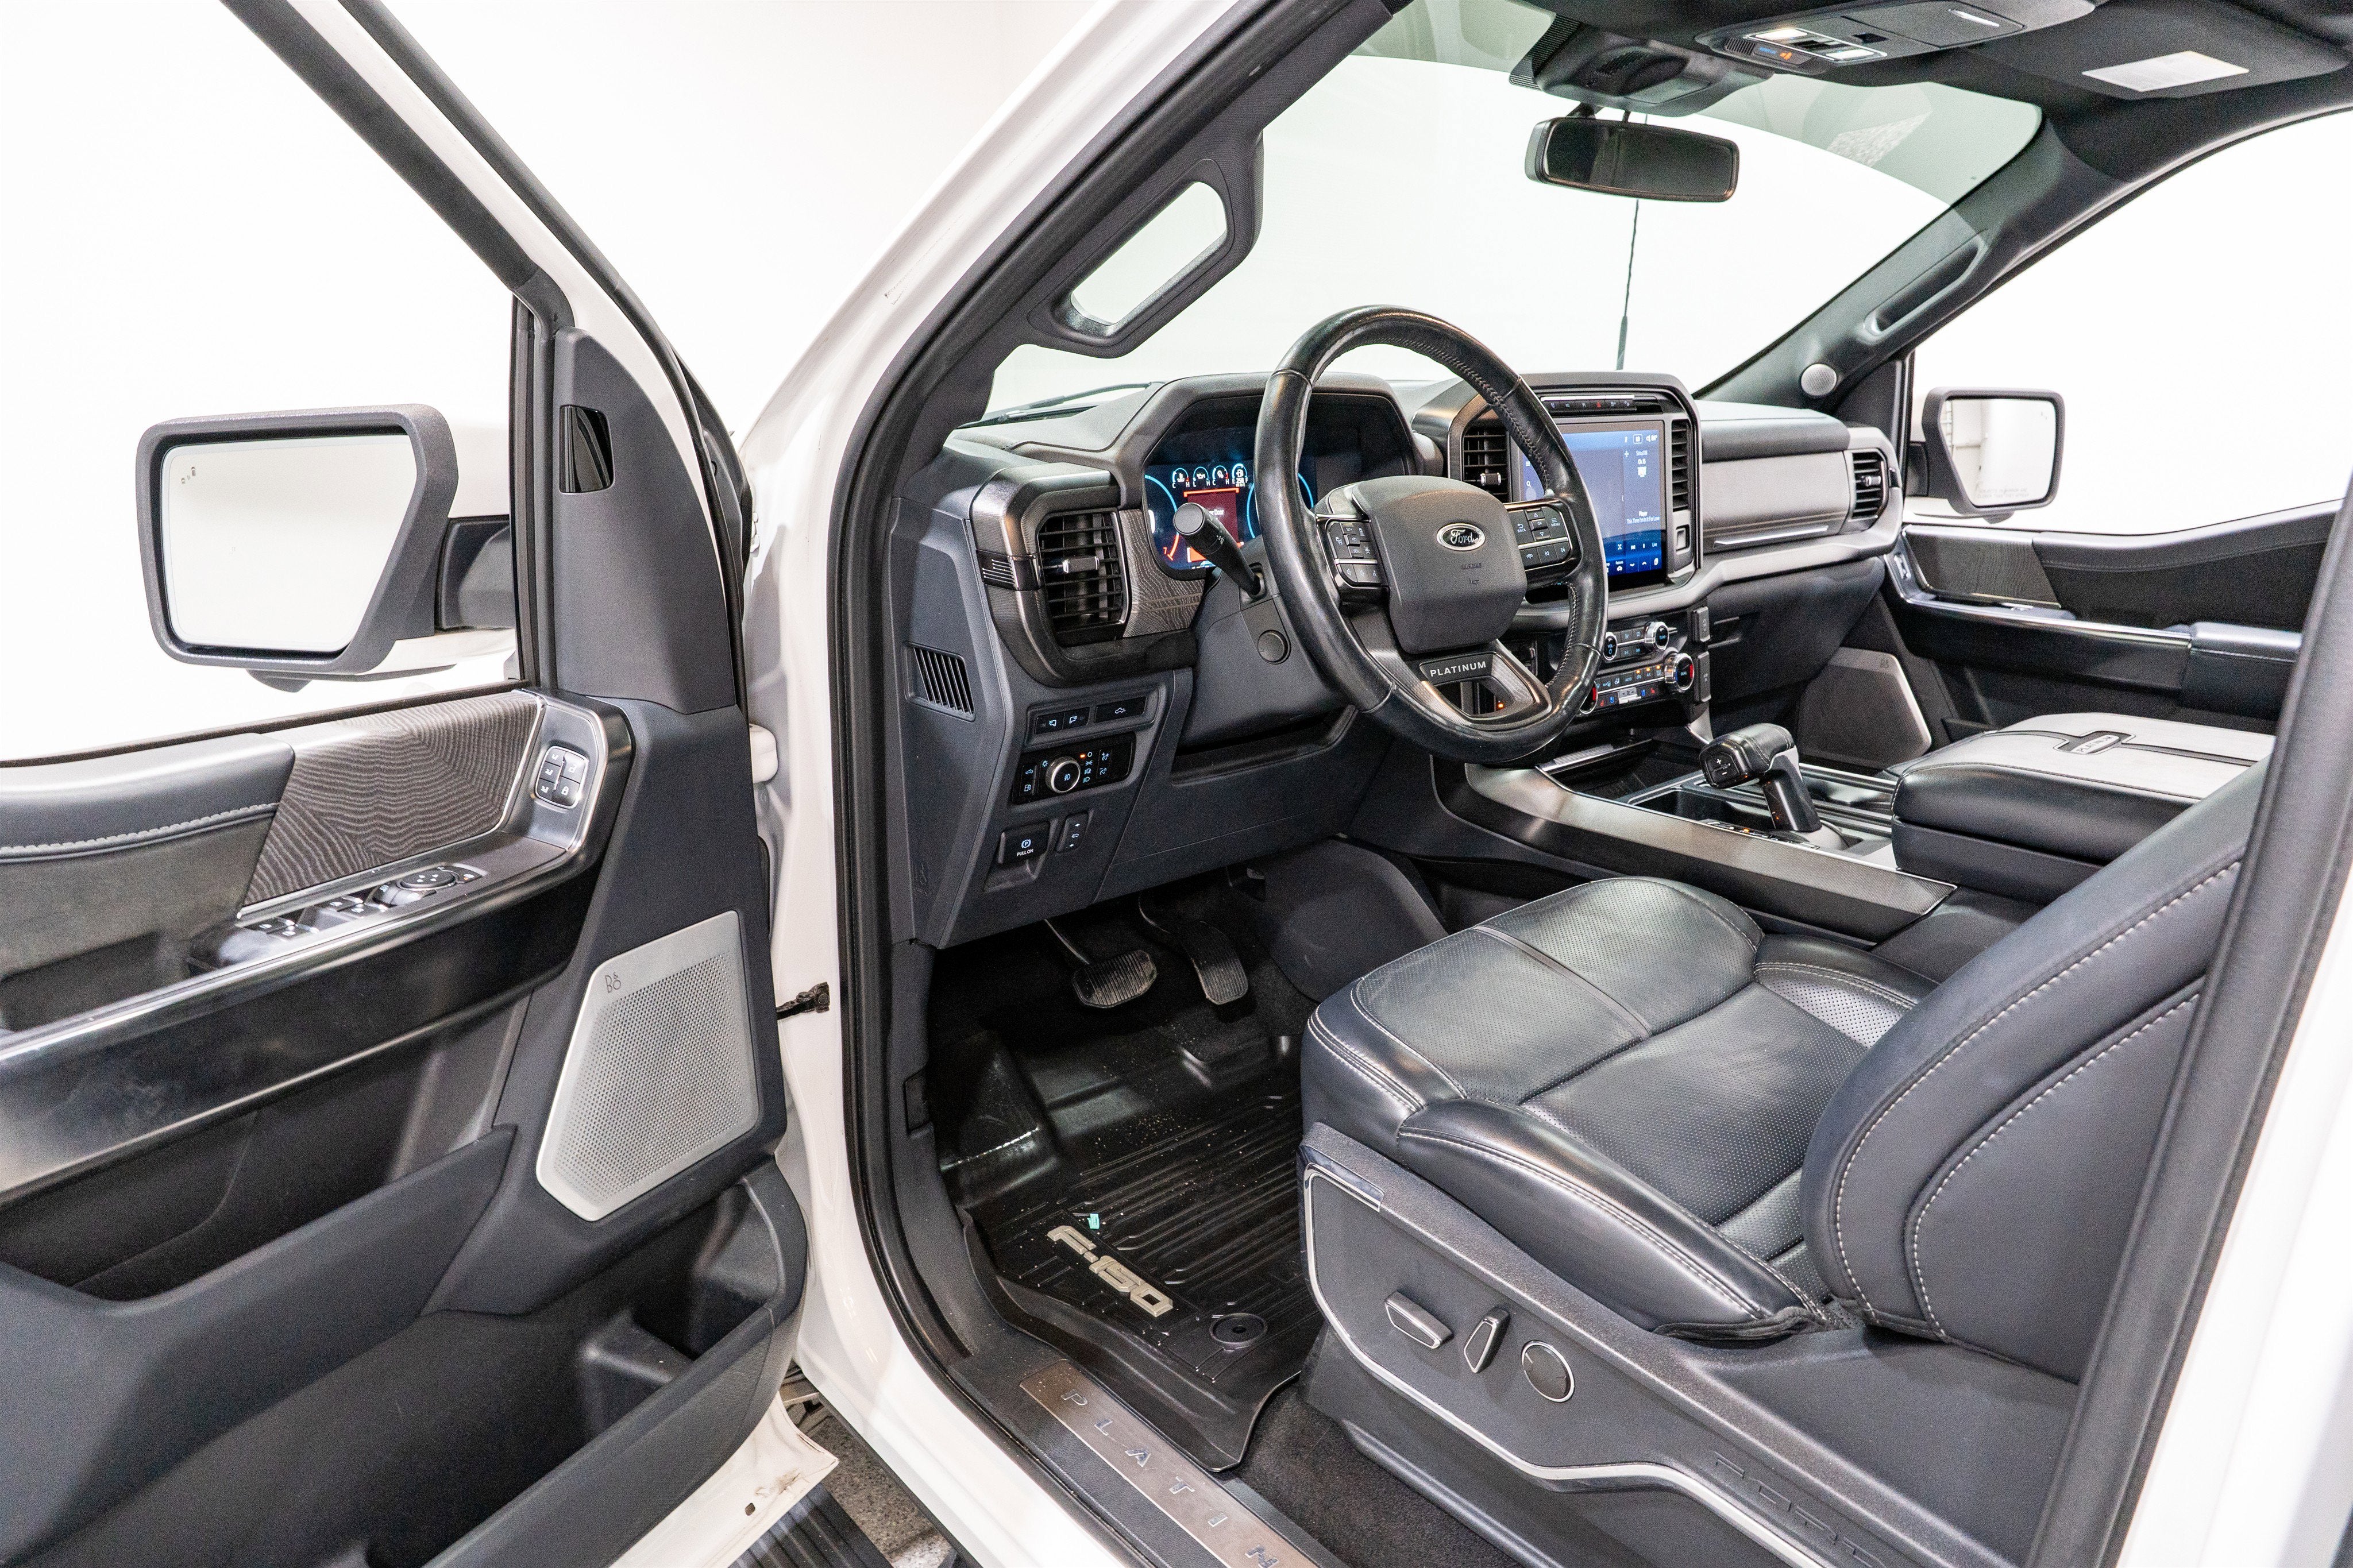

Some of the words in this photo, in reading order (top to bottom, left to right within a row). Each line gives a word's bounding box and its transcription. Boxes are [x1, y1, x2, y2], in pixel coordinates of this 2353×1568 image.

[1450, 529, 1479, 544] Ford
[1429, 661, 1487, 677] PLATINUM
[1047, 1225, 1174, 1317] F-150
